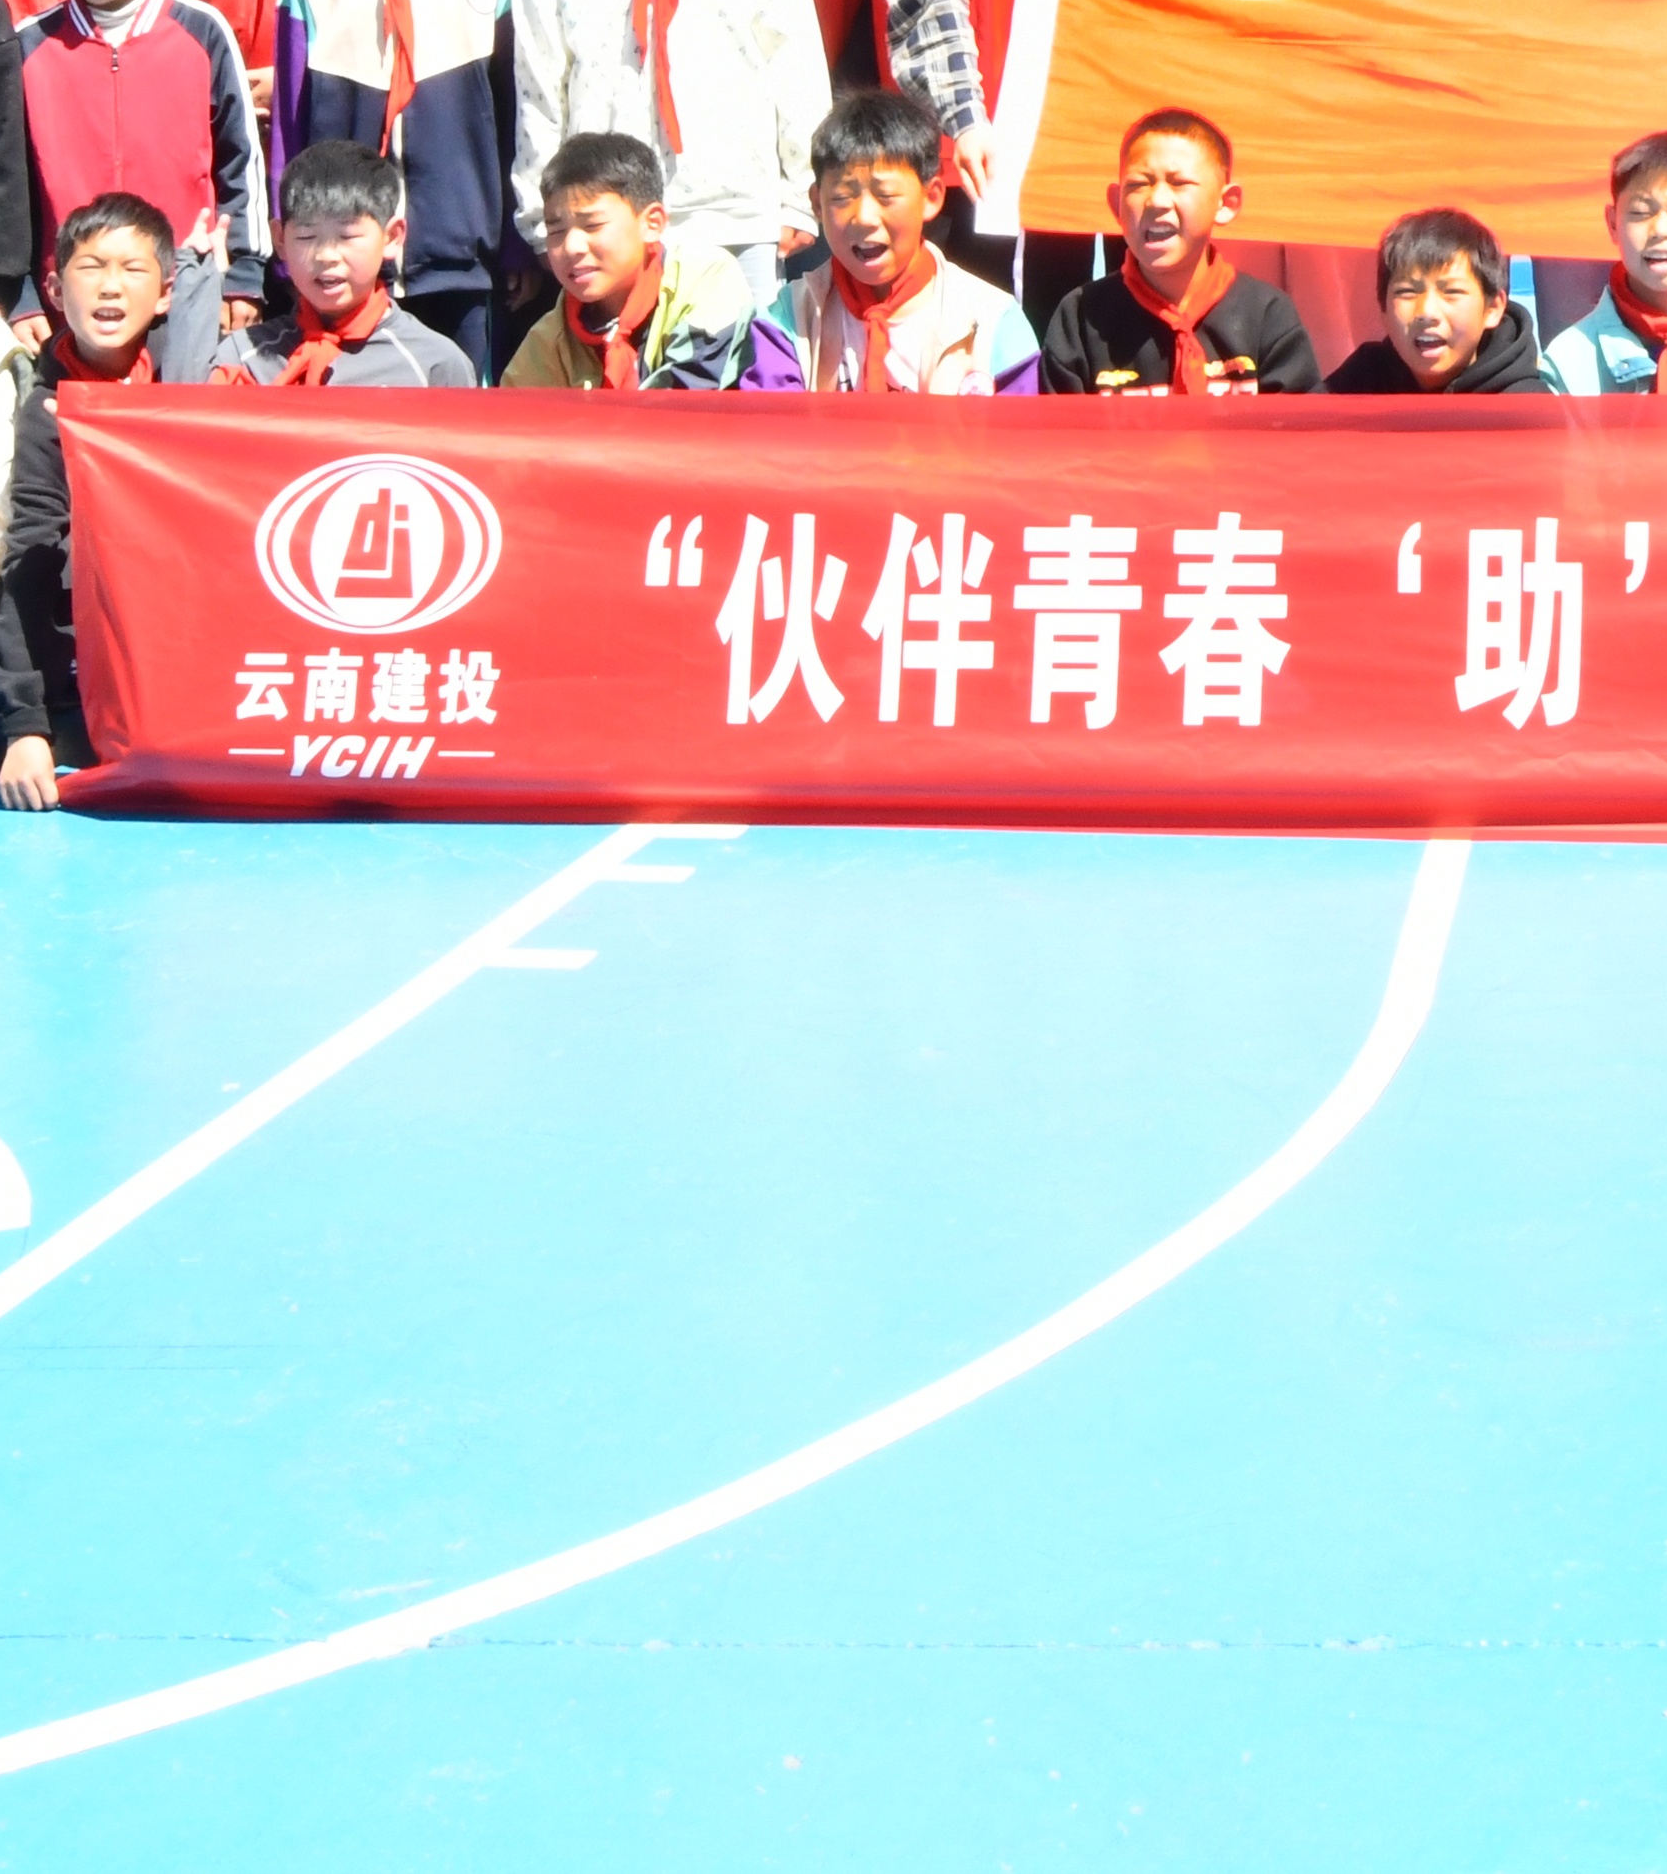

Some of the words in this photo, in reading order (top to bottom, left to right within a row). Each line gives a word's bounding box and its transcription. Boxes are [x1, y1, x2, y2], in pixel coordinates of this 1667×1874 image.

[233, 646, 501, 724] 云南建投
[284, 734, 433, 779] YCIH
